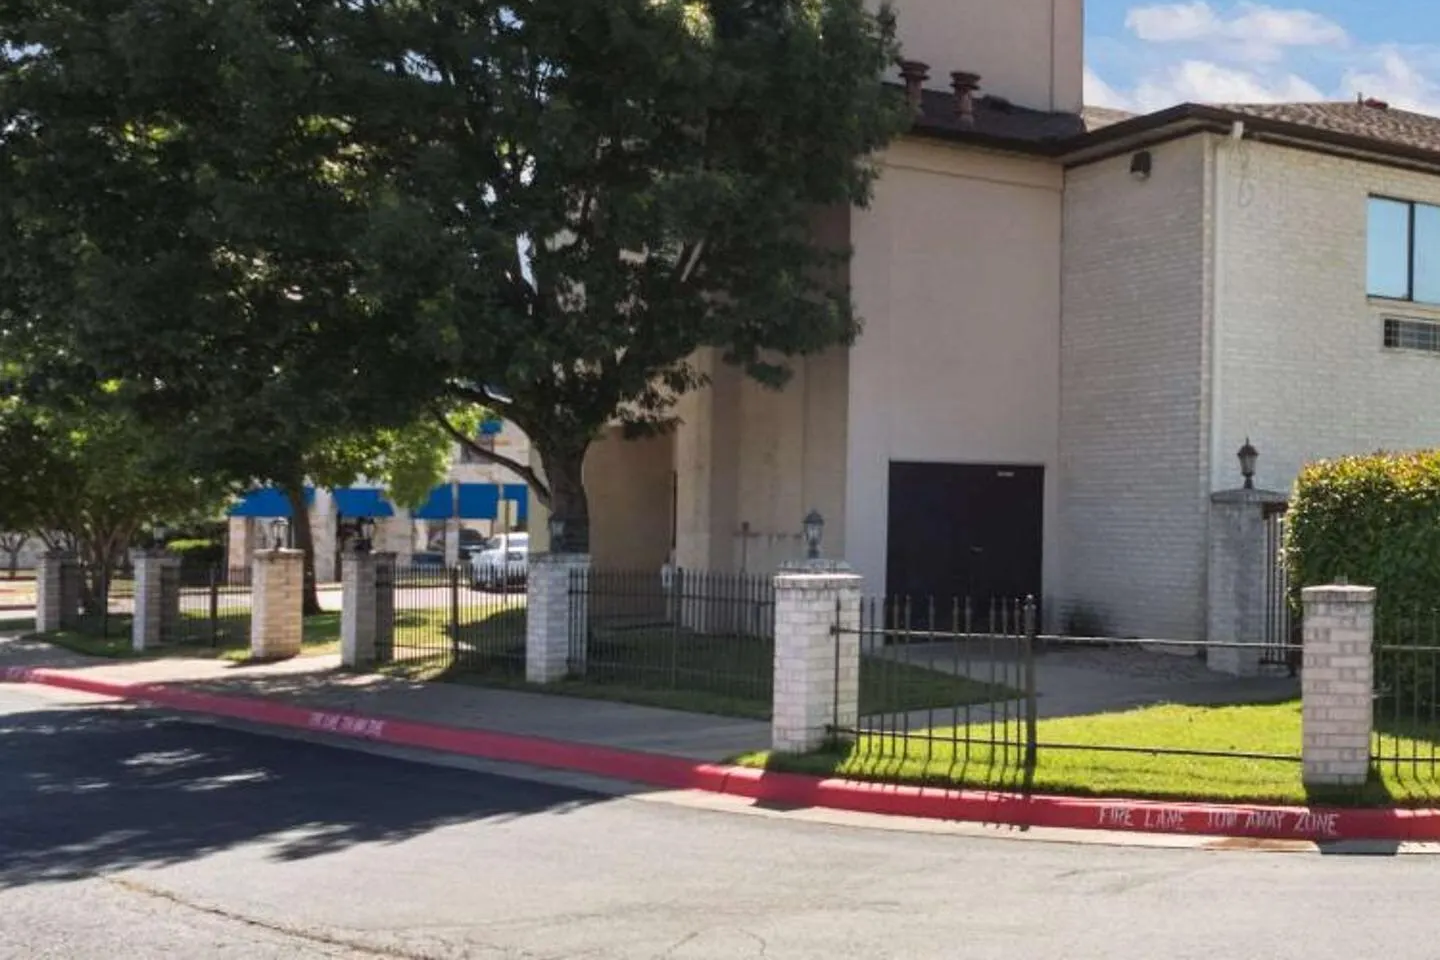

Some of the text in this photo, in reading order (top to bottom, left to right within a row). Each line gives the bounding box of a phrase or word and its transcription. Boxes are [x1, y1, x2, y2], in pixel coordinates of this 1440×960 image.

[1098, 806, 1339, 836] FIRE LANE TOW AWAY ZONE
